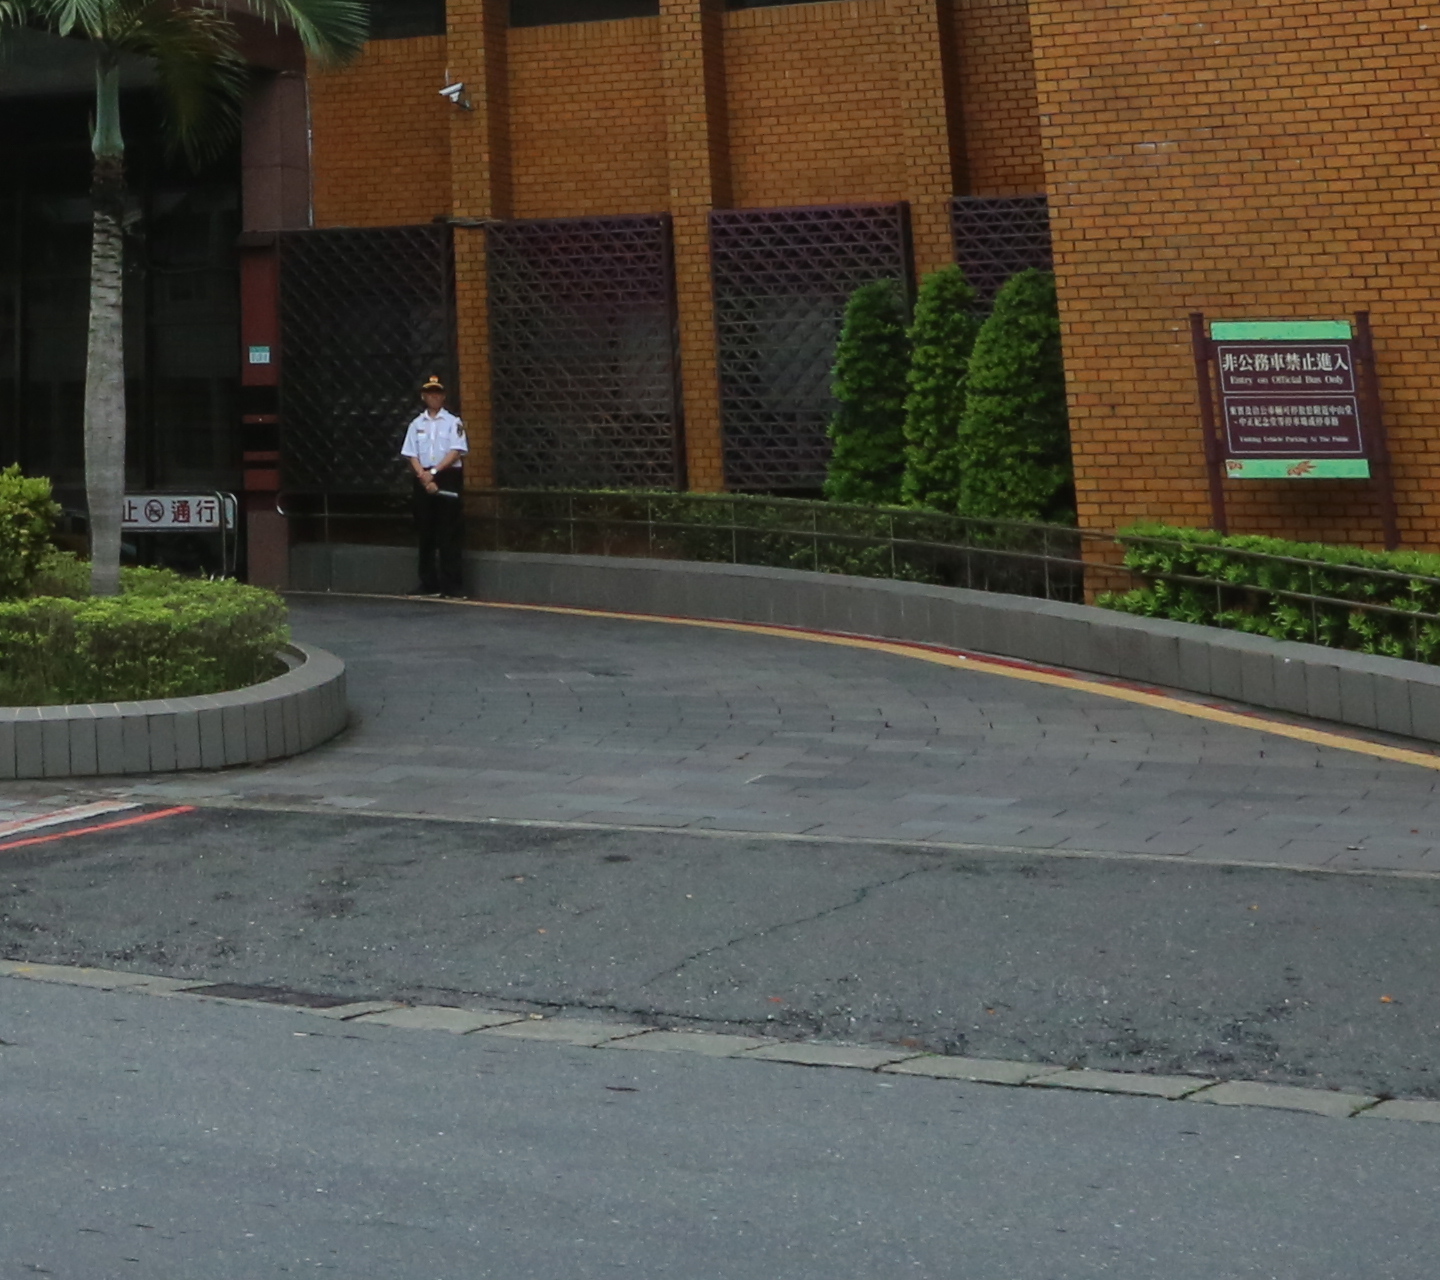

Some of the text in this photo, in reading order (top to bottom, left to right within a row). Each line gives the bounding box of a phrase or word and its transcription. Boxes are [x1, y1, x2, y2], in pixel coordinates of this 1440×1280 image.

[1222, 352, 1349, 371] 非公務車禁止進入
[1230, 375, 1253, 385] Entry
[1271, 374, 1302, 384] Official
[1324, 374, 1343, 385] Only
[171, 500, 215, 523] 通行
